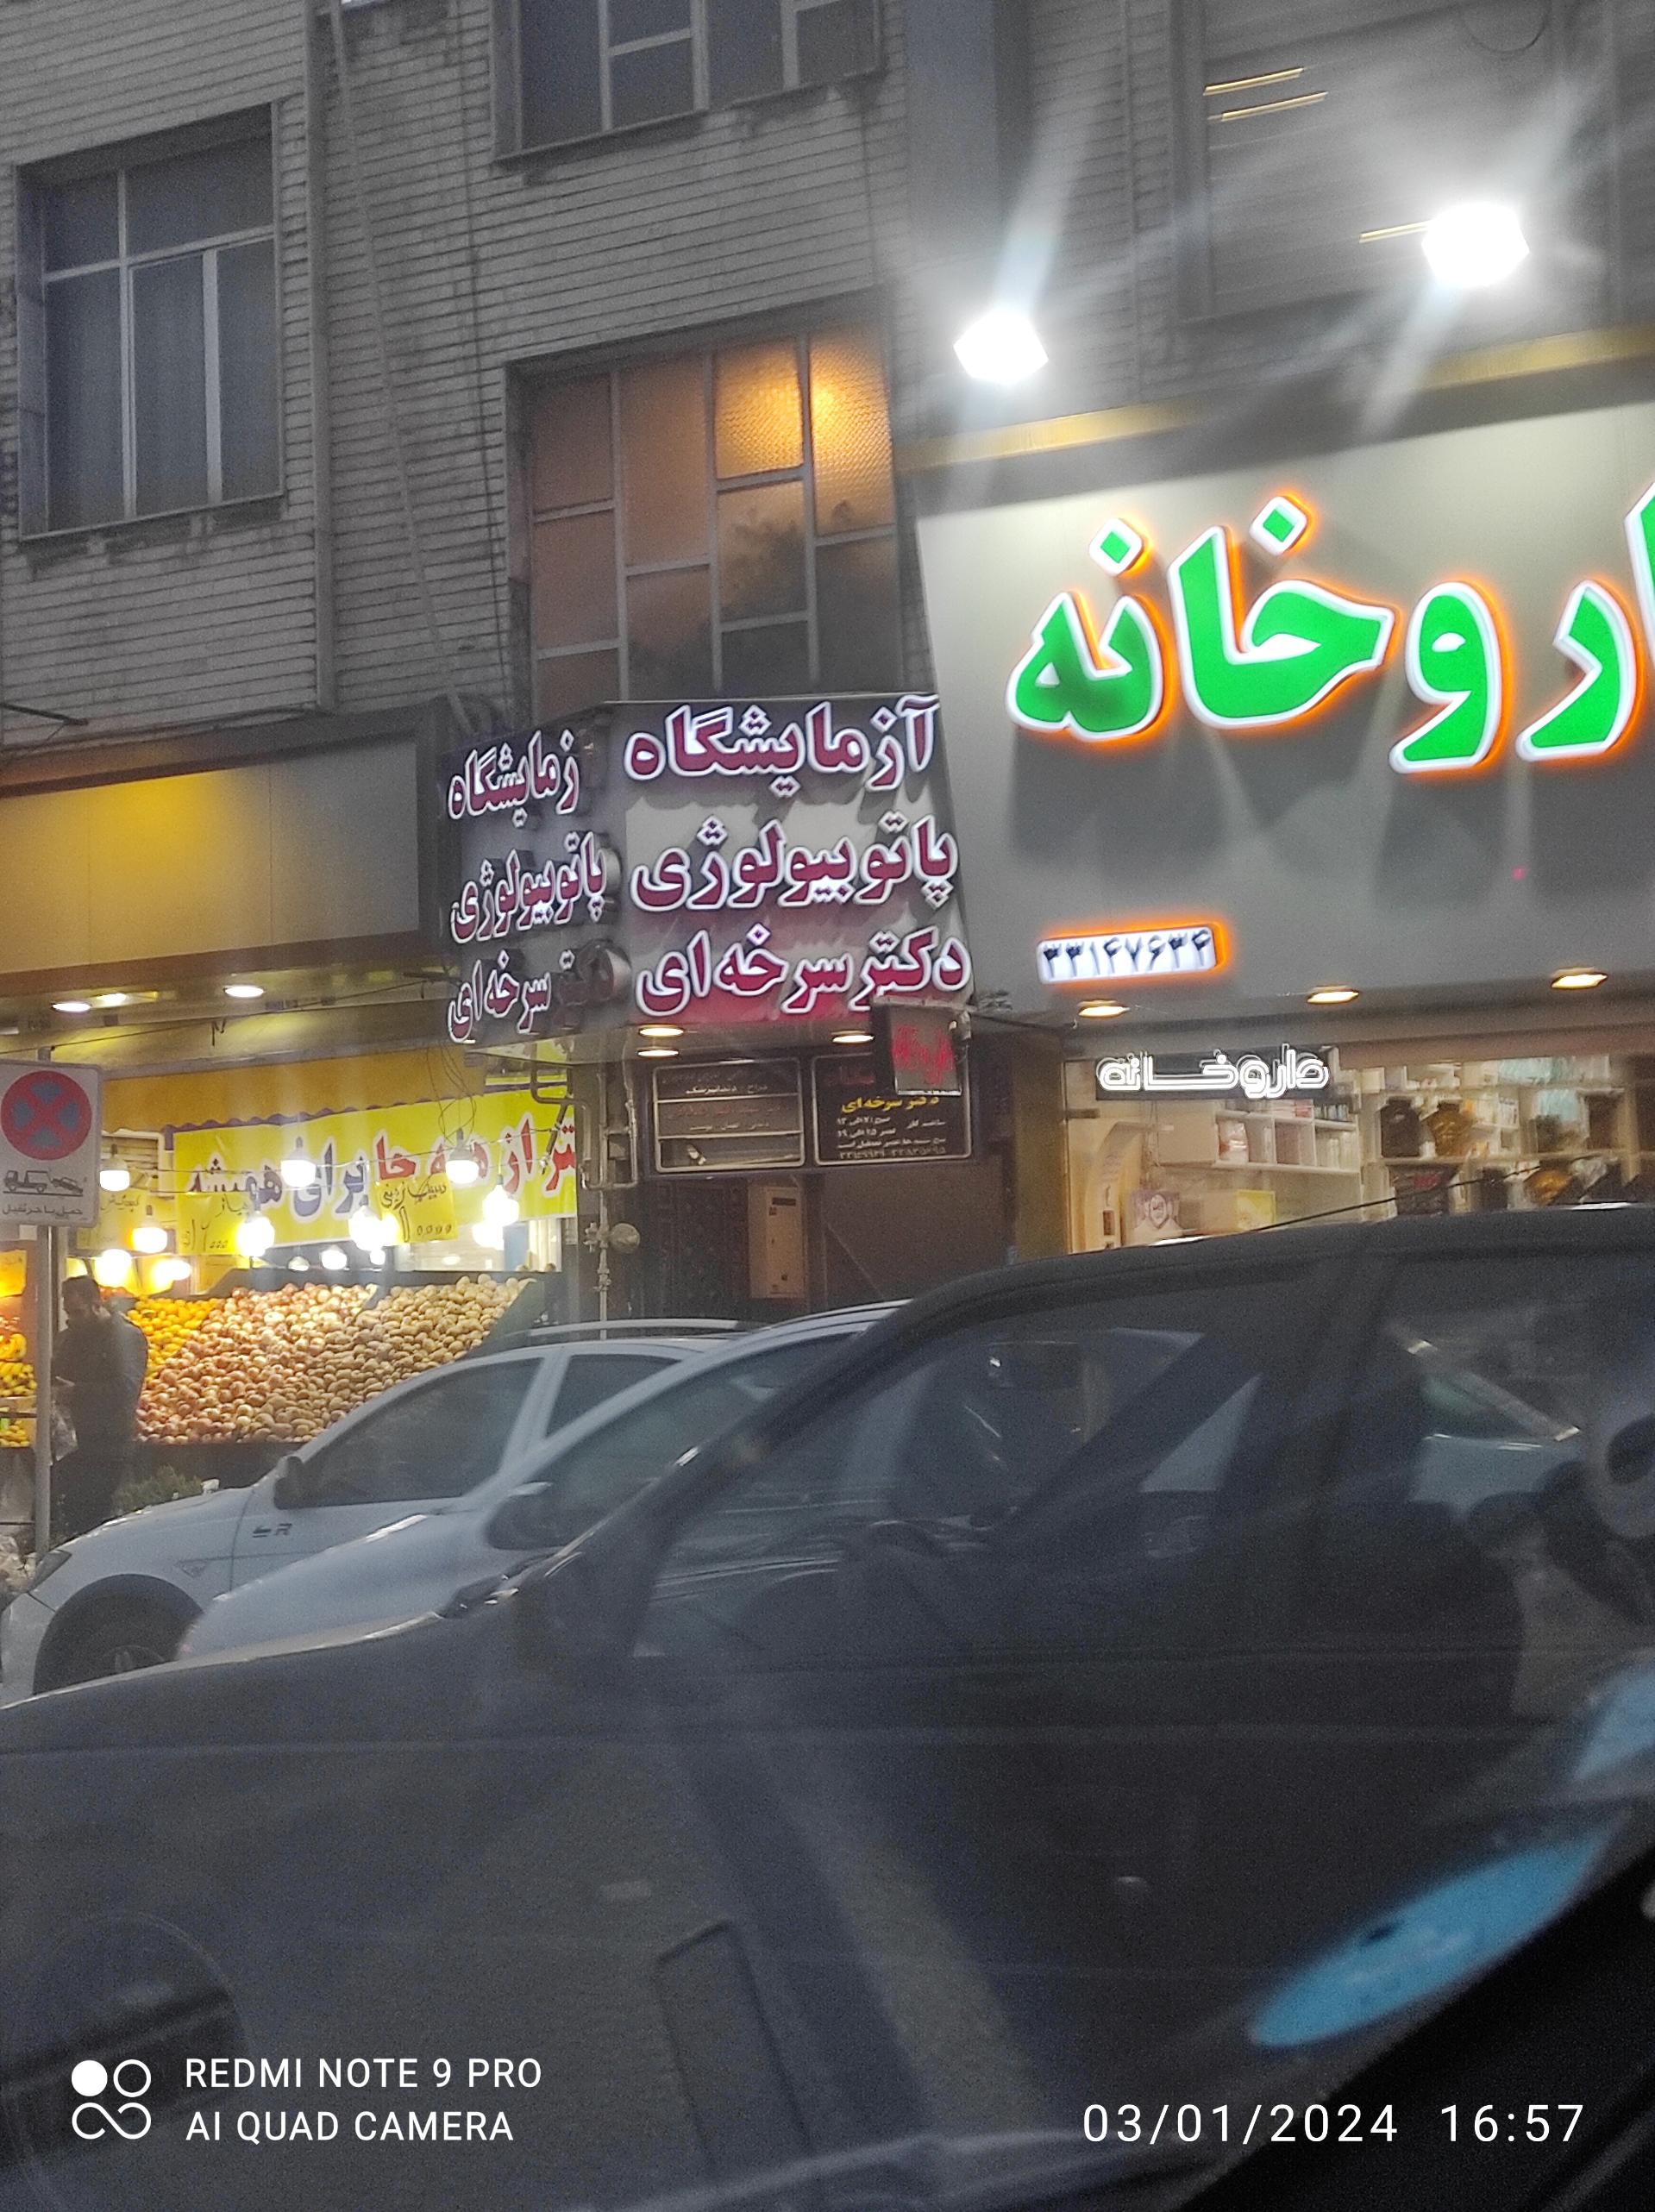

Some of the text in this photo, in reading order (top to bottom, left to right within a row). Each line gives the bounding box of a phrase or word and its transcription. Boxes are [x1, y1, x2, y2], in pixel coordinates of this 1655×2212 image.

[1006, 477, 1655, 774] روخانه
[624, 694, 940, 796] آزمایشگاه
[451, 830, 607, 944] پاتوبیولوژی
[630, 811, 958, 912] پاتوبیولوژی
[849, 926, 971, 1011] دکتر
[1096, 1043, 1329, 1099] داروخانه
[505, 1119, 533, 1194] از
